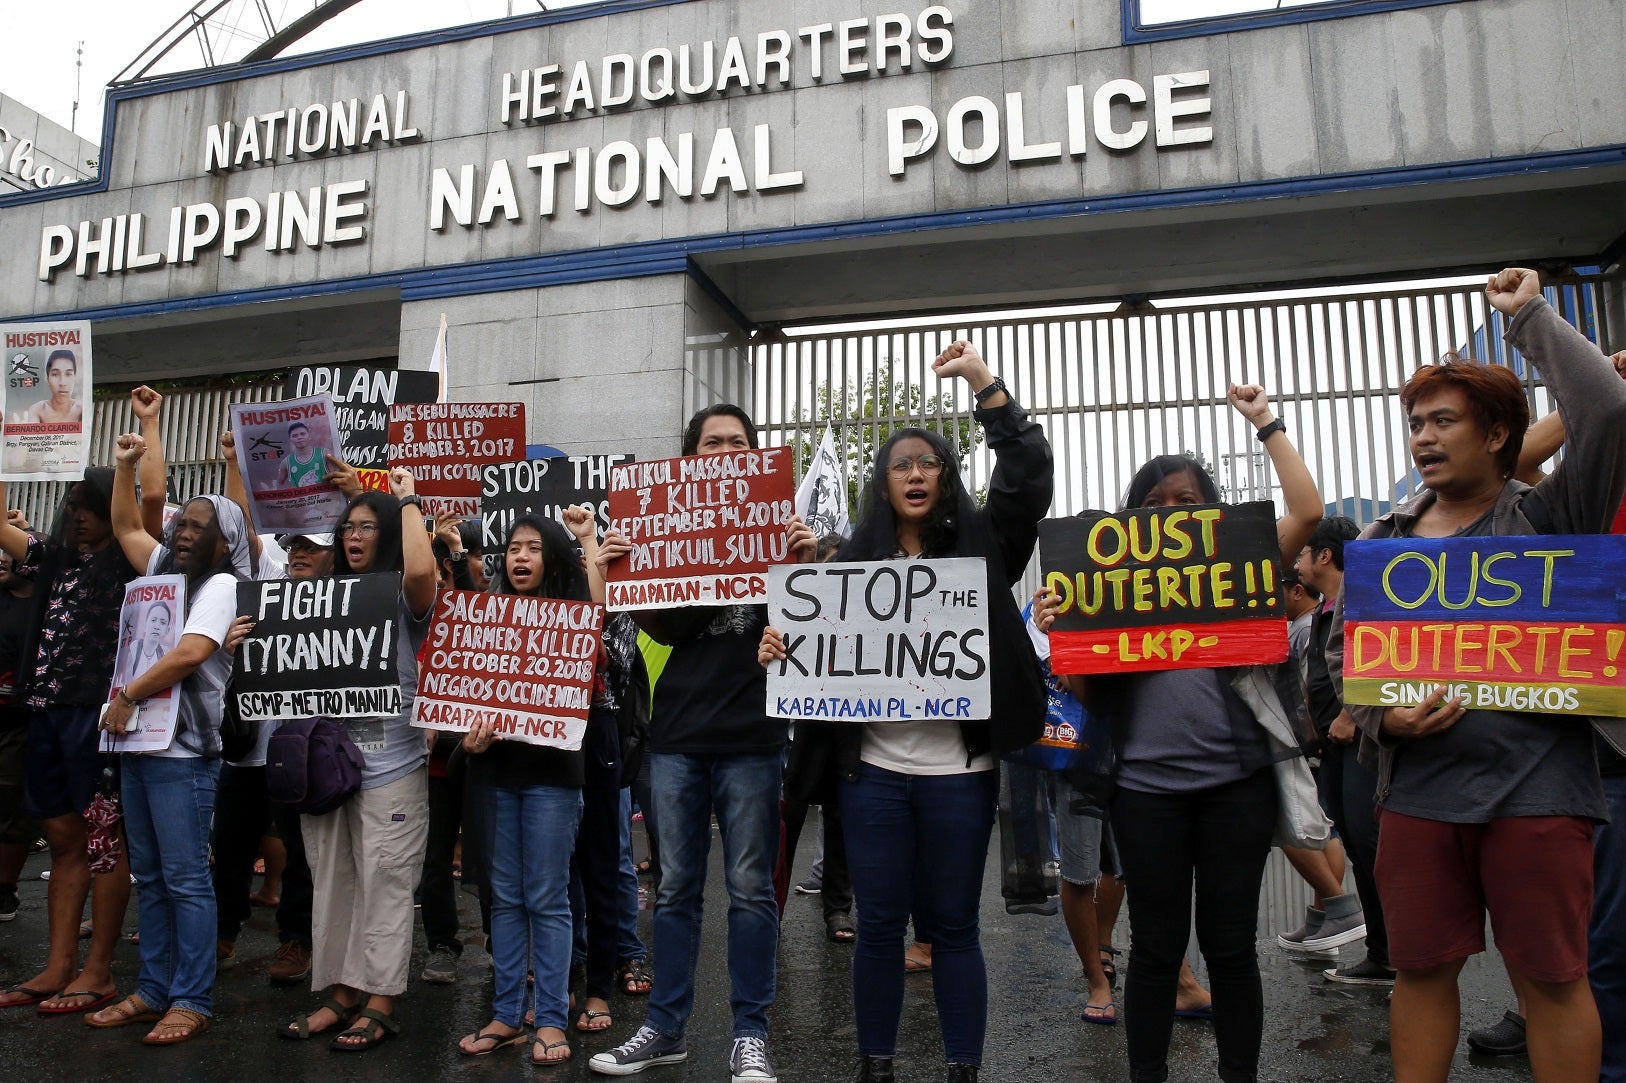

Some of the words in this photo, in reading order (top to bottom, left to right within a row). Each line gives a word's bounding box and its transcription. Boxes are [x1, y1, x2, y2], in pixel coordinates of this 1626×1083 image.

[205, 90, 423, 173] NATIONAL
[501, 5, 954, 125] HEADQUARTERS
[39, 179, 370, 282] PHILIPPINE
[430, 123, 804, 231] NATIONAL
[887, 70, 1213, 177] POLICE
[6, 330, 81, 348] HUSTISYA!
[296, 367, 399, 405] OPLAN
[48, 424, 79, 433] CLARION
[240, 402, 327, 426] HUSTISYA!
[334, 406, 386, 431] ATAGAN
[417, 404, 448, 420] SEBU
[450, 403, 520, 419] MASSACRE
[389, 440, 454, 460] DECEMBER
[403, 422, 414, 443] 8
[427, 421, 484, 440] KILLED
[443, 463, 481, 481] COTA
[482, 459, 549, 498] STOP
[611, 461, 676, 492] PATIKUL
[679, 450, 782, 483] MASSACRE
[636, 487, 652, 515] 7
[667, 479, 750, 514] KILLED
[610, 509, 716, 543] SEPTEMBER
[1087, 508, 1224, 566] OUST
[726, 532, 788, 565] SULU
[781, 564, 937, 623] STOP
[939, 589, 978, 607] THE
[1046, 558, 1277, 617] DUTERTE!!
[1382, 550, 1576, 610] OUST
[258, 578, 361, 621] FIGHT
[439, 590, 509, 624] SAGAY
[512, 598, 603, 631] MASSACRE
[241, 619, 393, 675] TYRANNY!
[433, 622, 449, 648] 9
[451, 624, 522, 653] FARMERS
[526, 629, 596, 660] KILLED
[779, 628, 986, 681] KILLINGS
[431, 650, 520, 675] OCTOBER
[345, 688, 402, 714] MANILA
[423, 671, 495, 701] NEGROS
[496, 679, 590, 710] OCCIDENTAL
[777, 697, 882, 718] KABATAAN
[1379, 682, 1472, 707] SINING
[1477, 683, 1580, 710] BUGKOS
